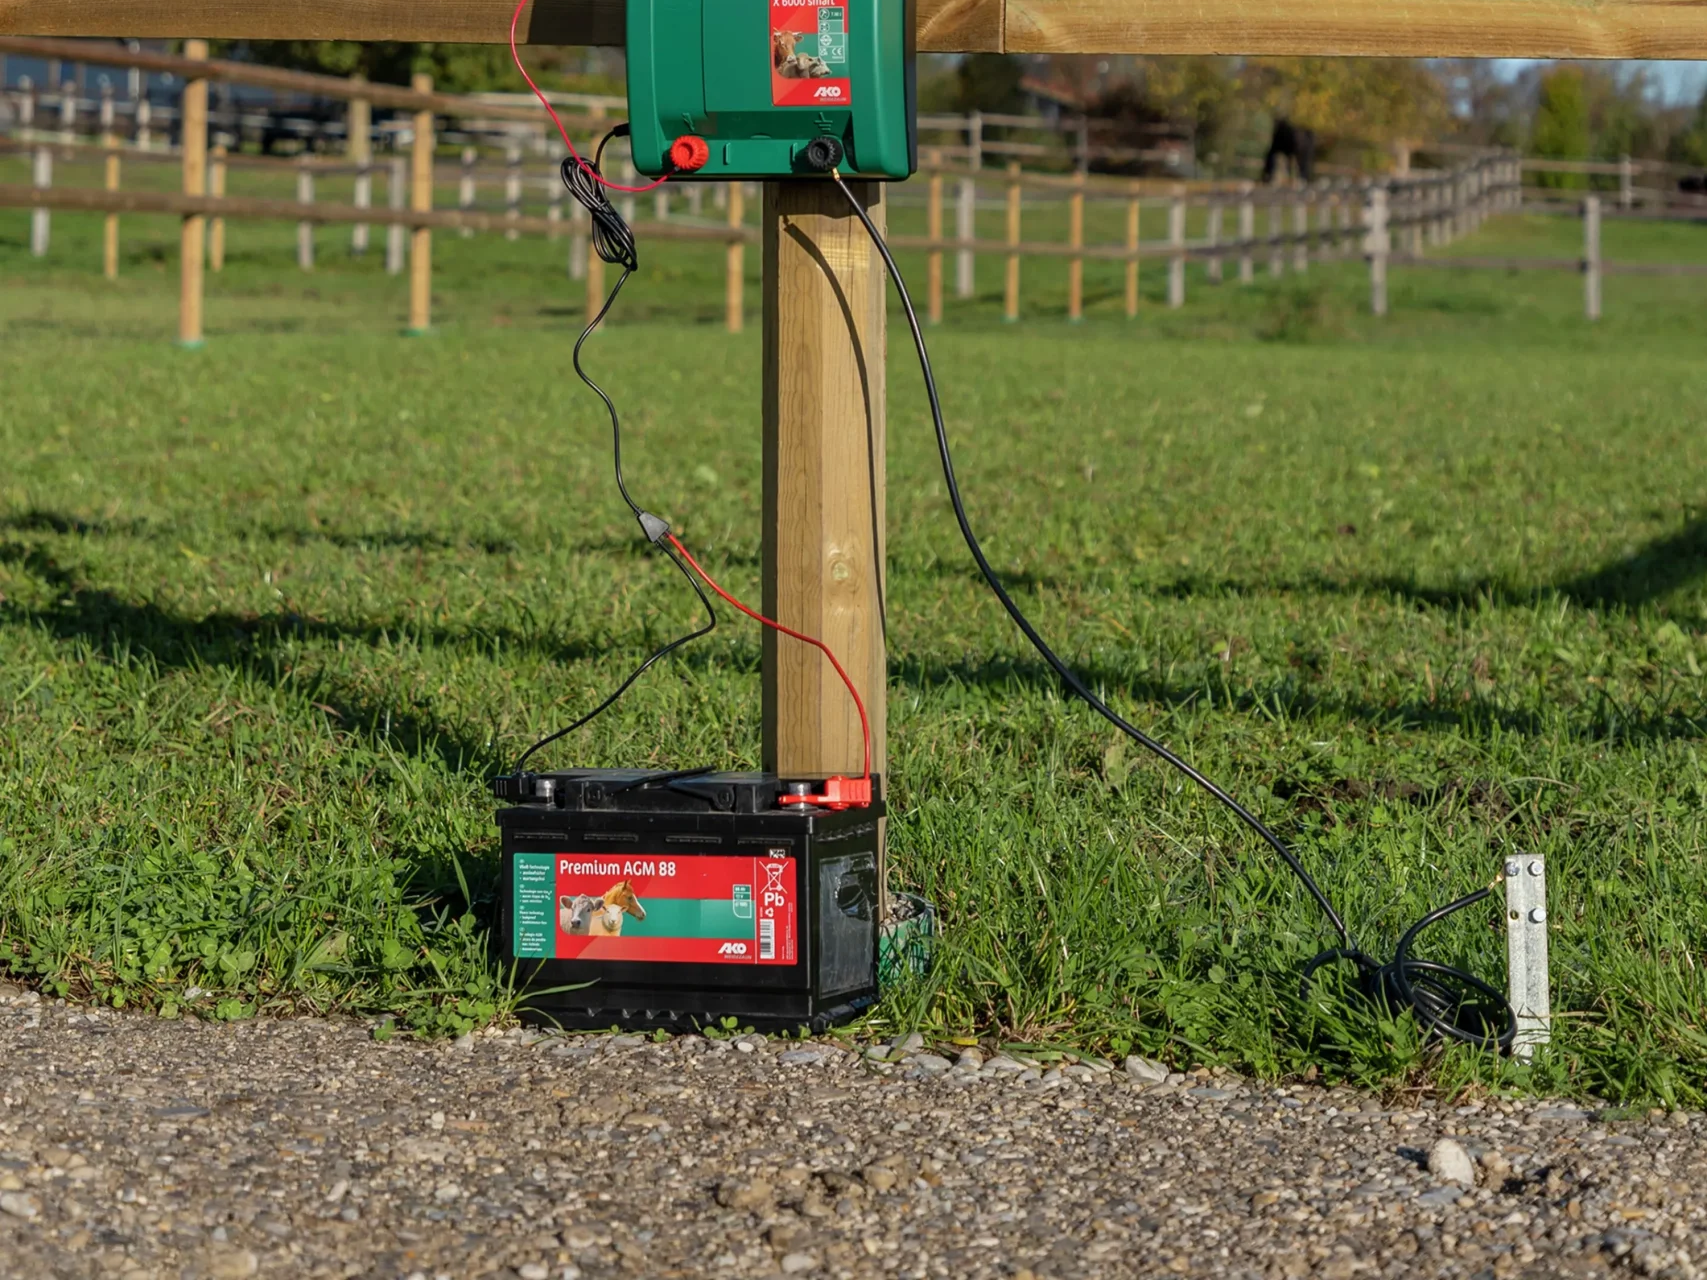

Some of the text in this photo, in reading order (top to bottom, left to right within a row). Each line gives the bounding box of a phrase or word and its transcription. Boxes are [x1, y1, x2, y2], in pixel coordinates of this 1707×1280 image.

[813, 86, 841, 97] AKO
[560, 859, 676, 877] Premium AGM 88
[764, 892, 785, 907] Pb
[718, 942, 747, 954] AKO
